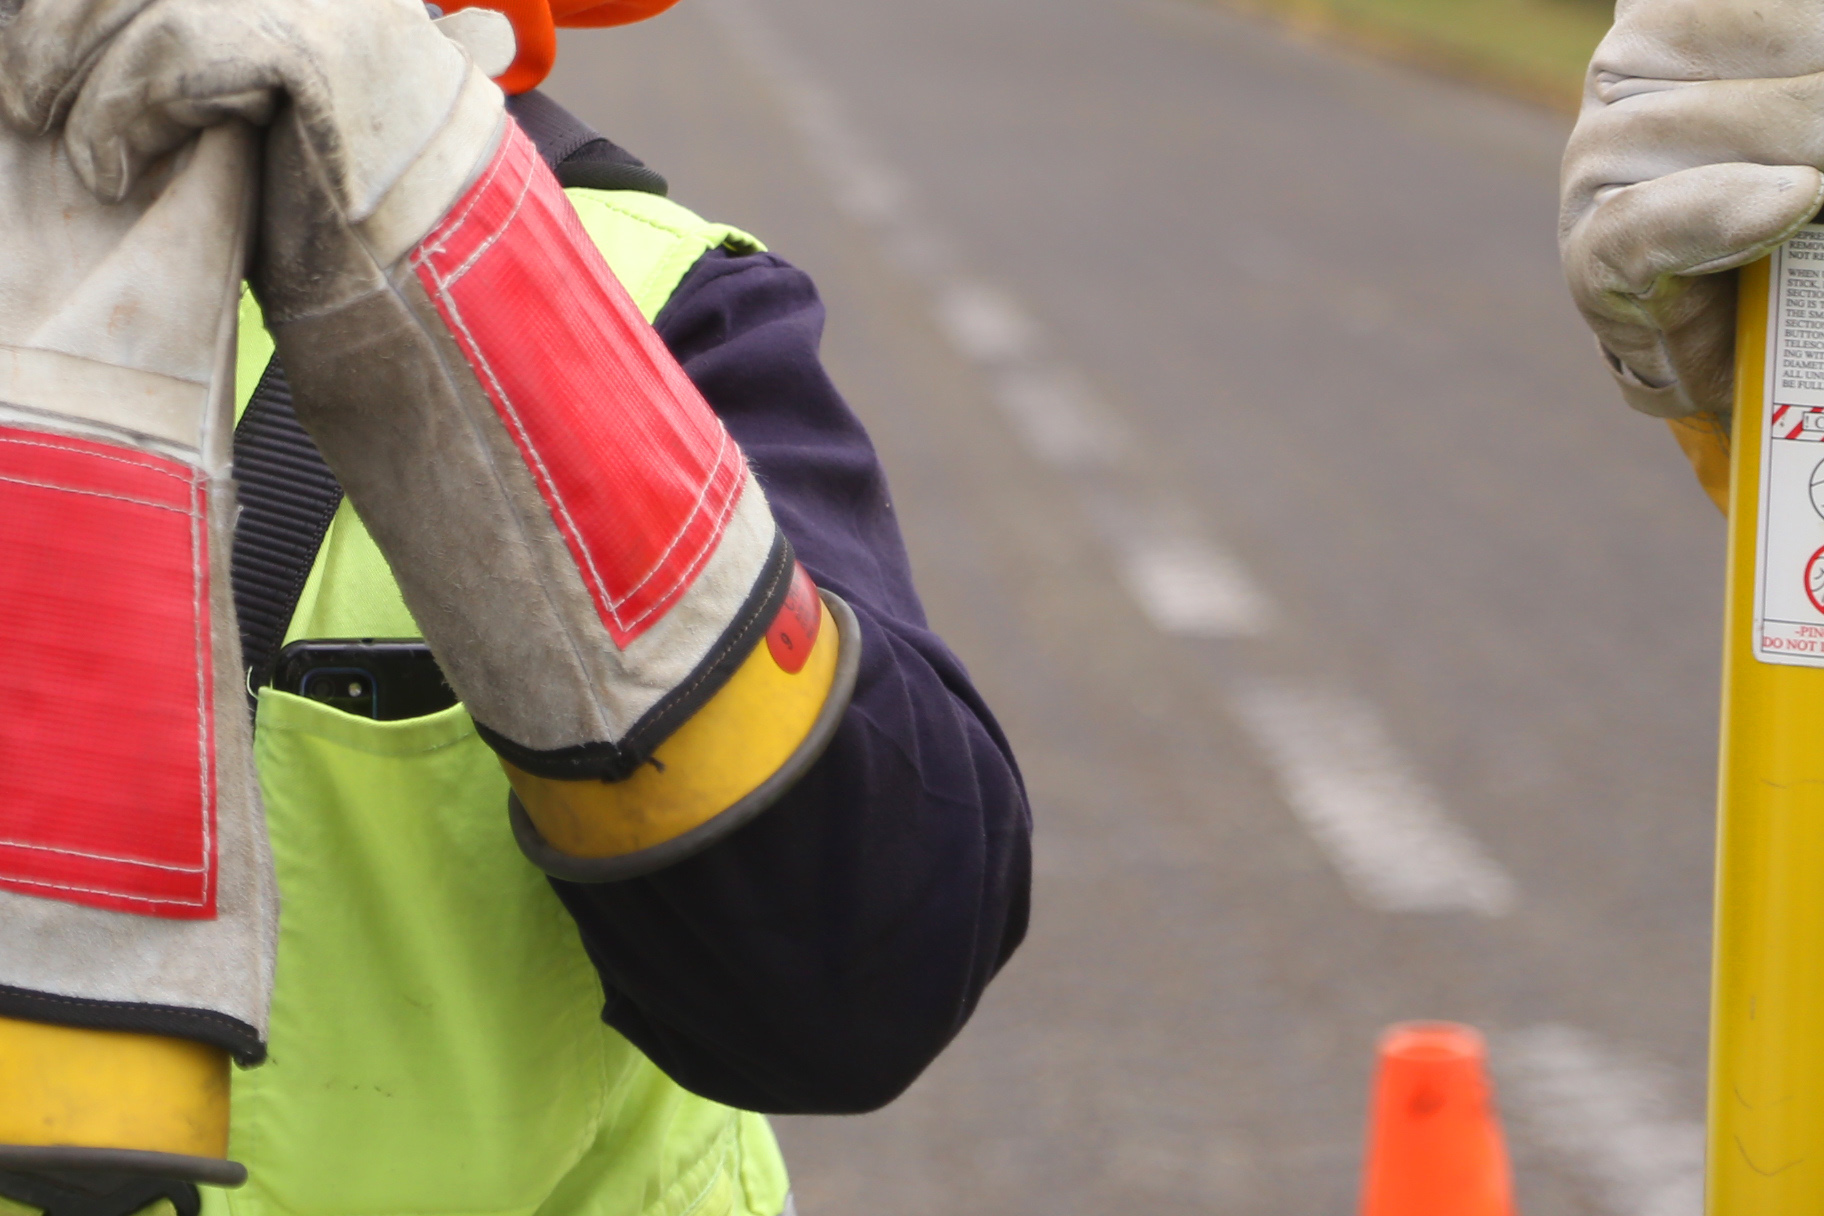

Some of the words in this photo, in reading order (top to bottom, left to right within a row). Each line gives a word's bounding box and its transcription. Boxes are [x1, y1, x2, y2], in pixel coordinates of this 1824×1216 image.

[1785, 319, 1824, 329] SECTIO
[1762, 636, 1783, 648] DO
[1787, 638, 1817, 651] NOT
